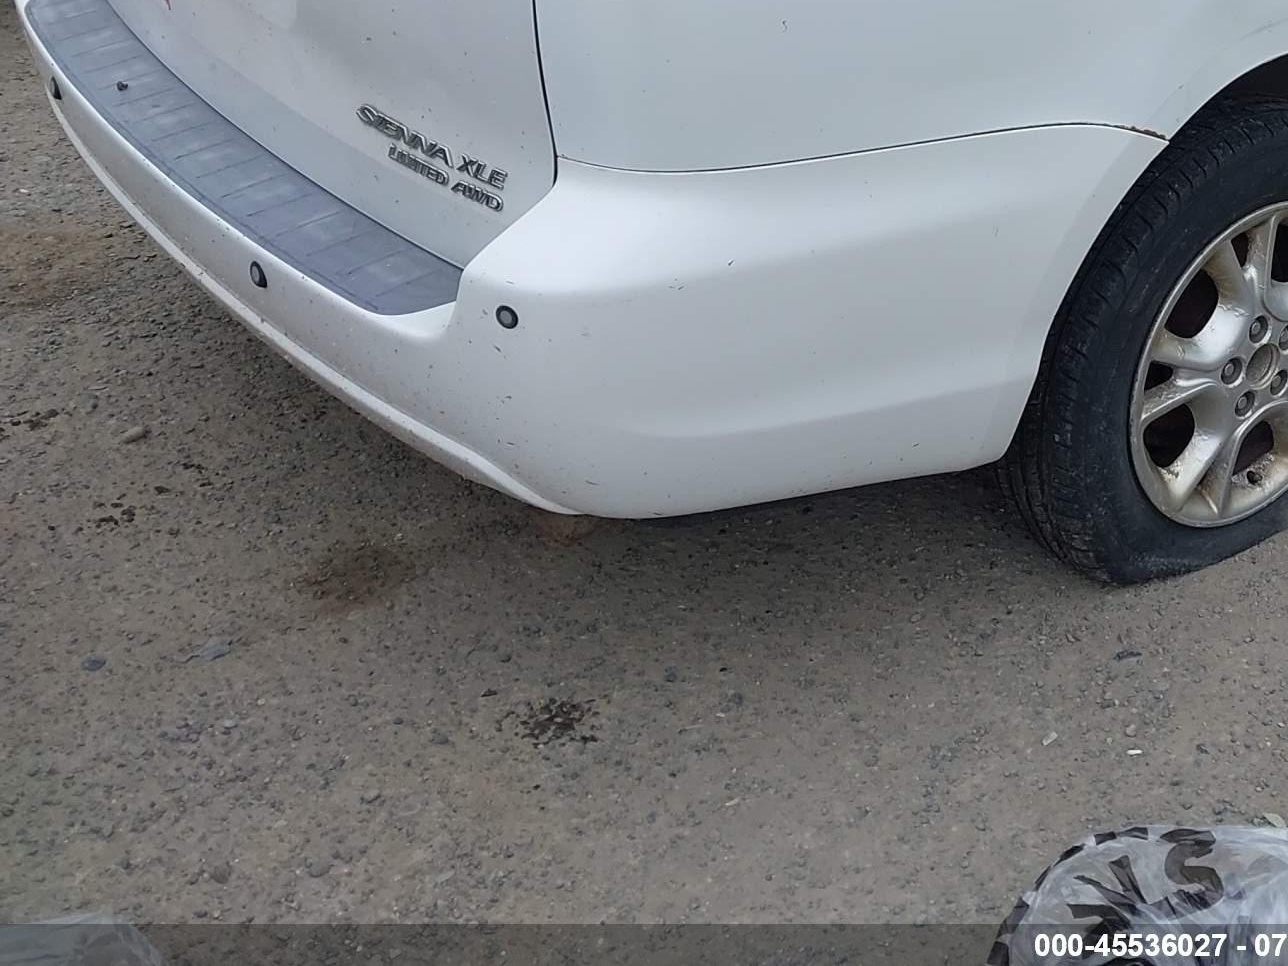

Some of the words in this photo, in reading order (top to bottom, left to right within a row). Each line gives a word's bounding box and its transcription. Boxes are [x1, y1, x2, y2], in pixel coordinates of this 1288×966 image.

[356, 104, 453, 168] SIENNA
[457, 153, 508, 190] XLE
[387, 143, 450, 186] LIMITED
[451, 180, 504, 212] AWD
